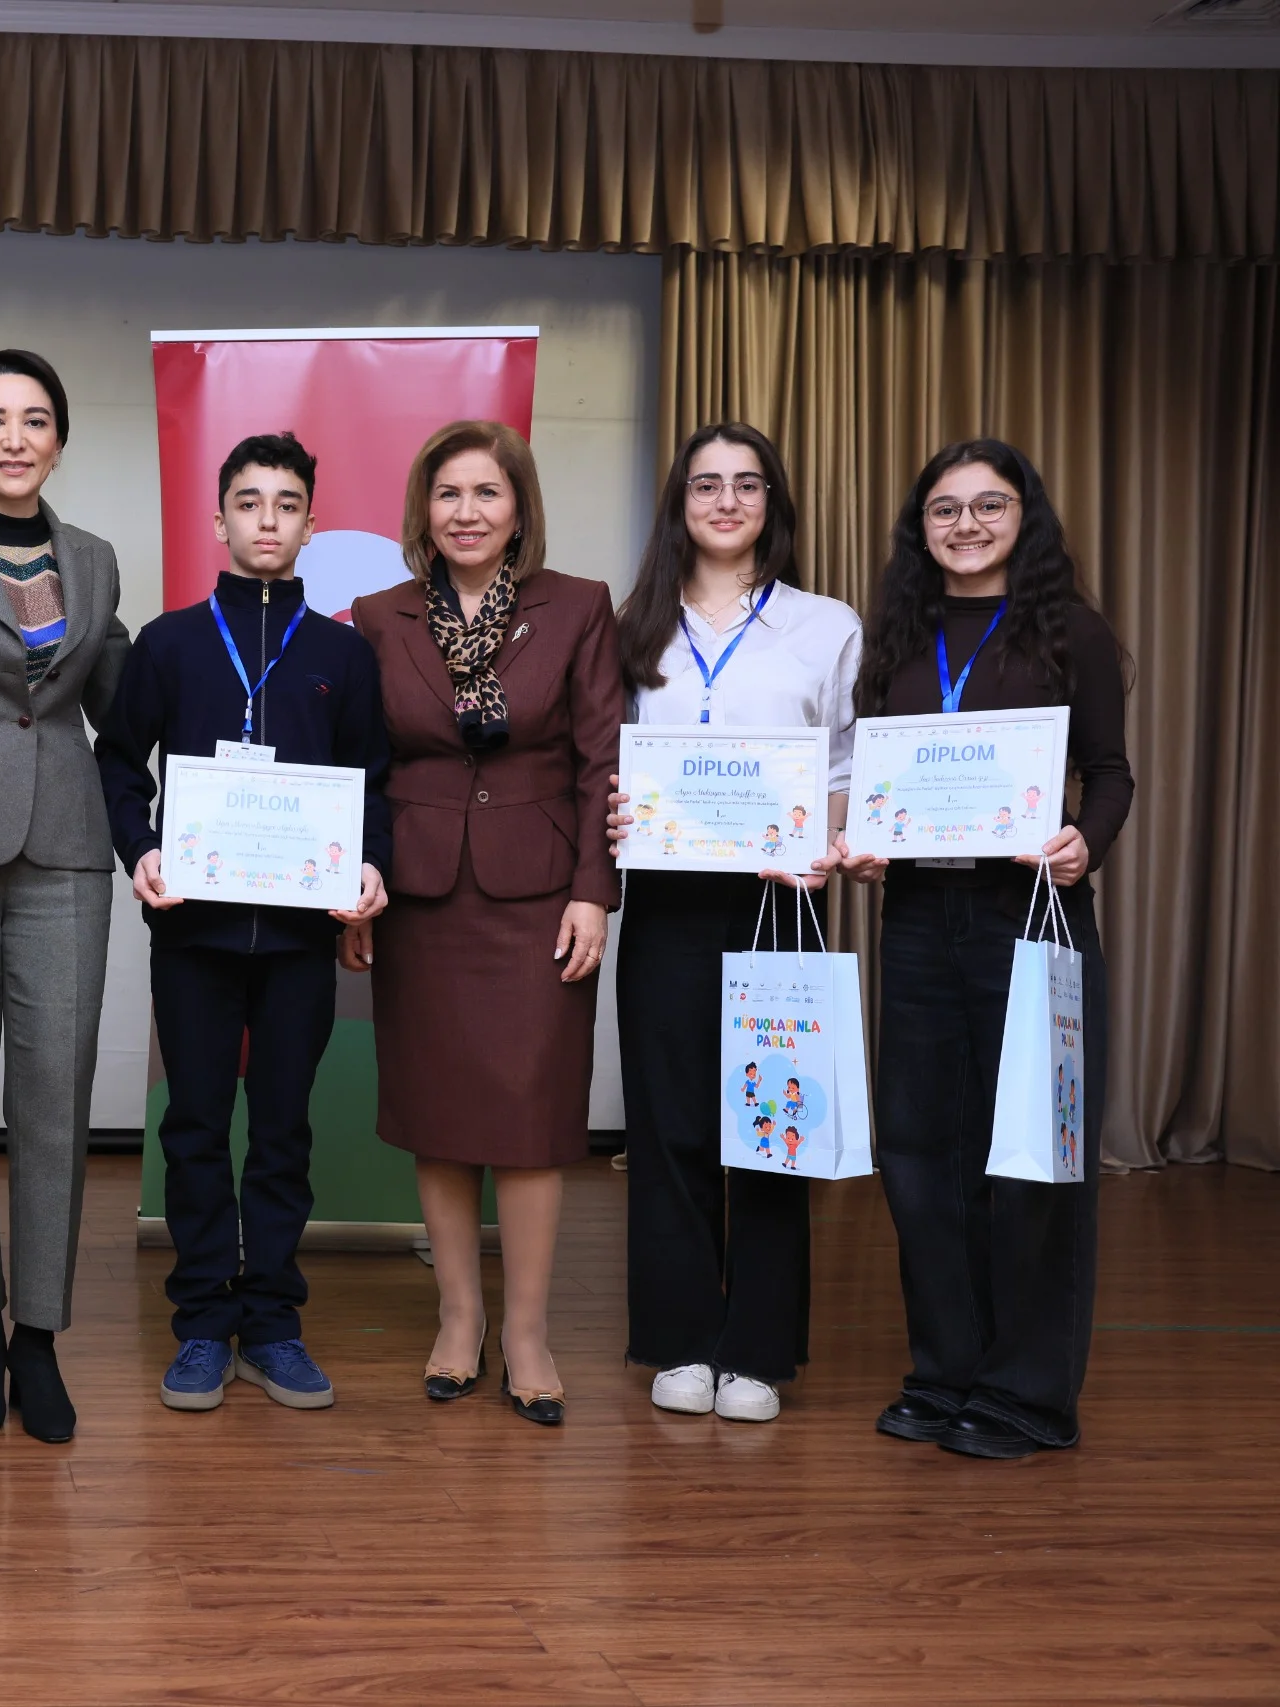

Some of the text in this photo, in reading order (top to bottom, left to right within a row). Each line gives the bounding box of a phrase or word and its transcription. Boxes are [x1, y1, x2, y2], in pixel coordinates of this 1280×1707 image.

[916, 743, 995, 764] DİPLOM
[683, 756, 760, 777] DİPLOM
[226, 788, 300, 812] DİPLOM
[934, 833, 964, 842] PARLA
[246, 880, 274, 889] PARLA
[734, 1014, 821, 1033] HÜQUQLARINLA
[756, 1034, 795, 1050] PARLA
